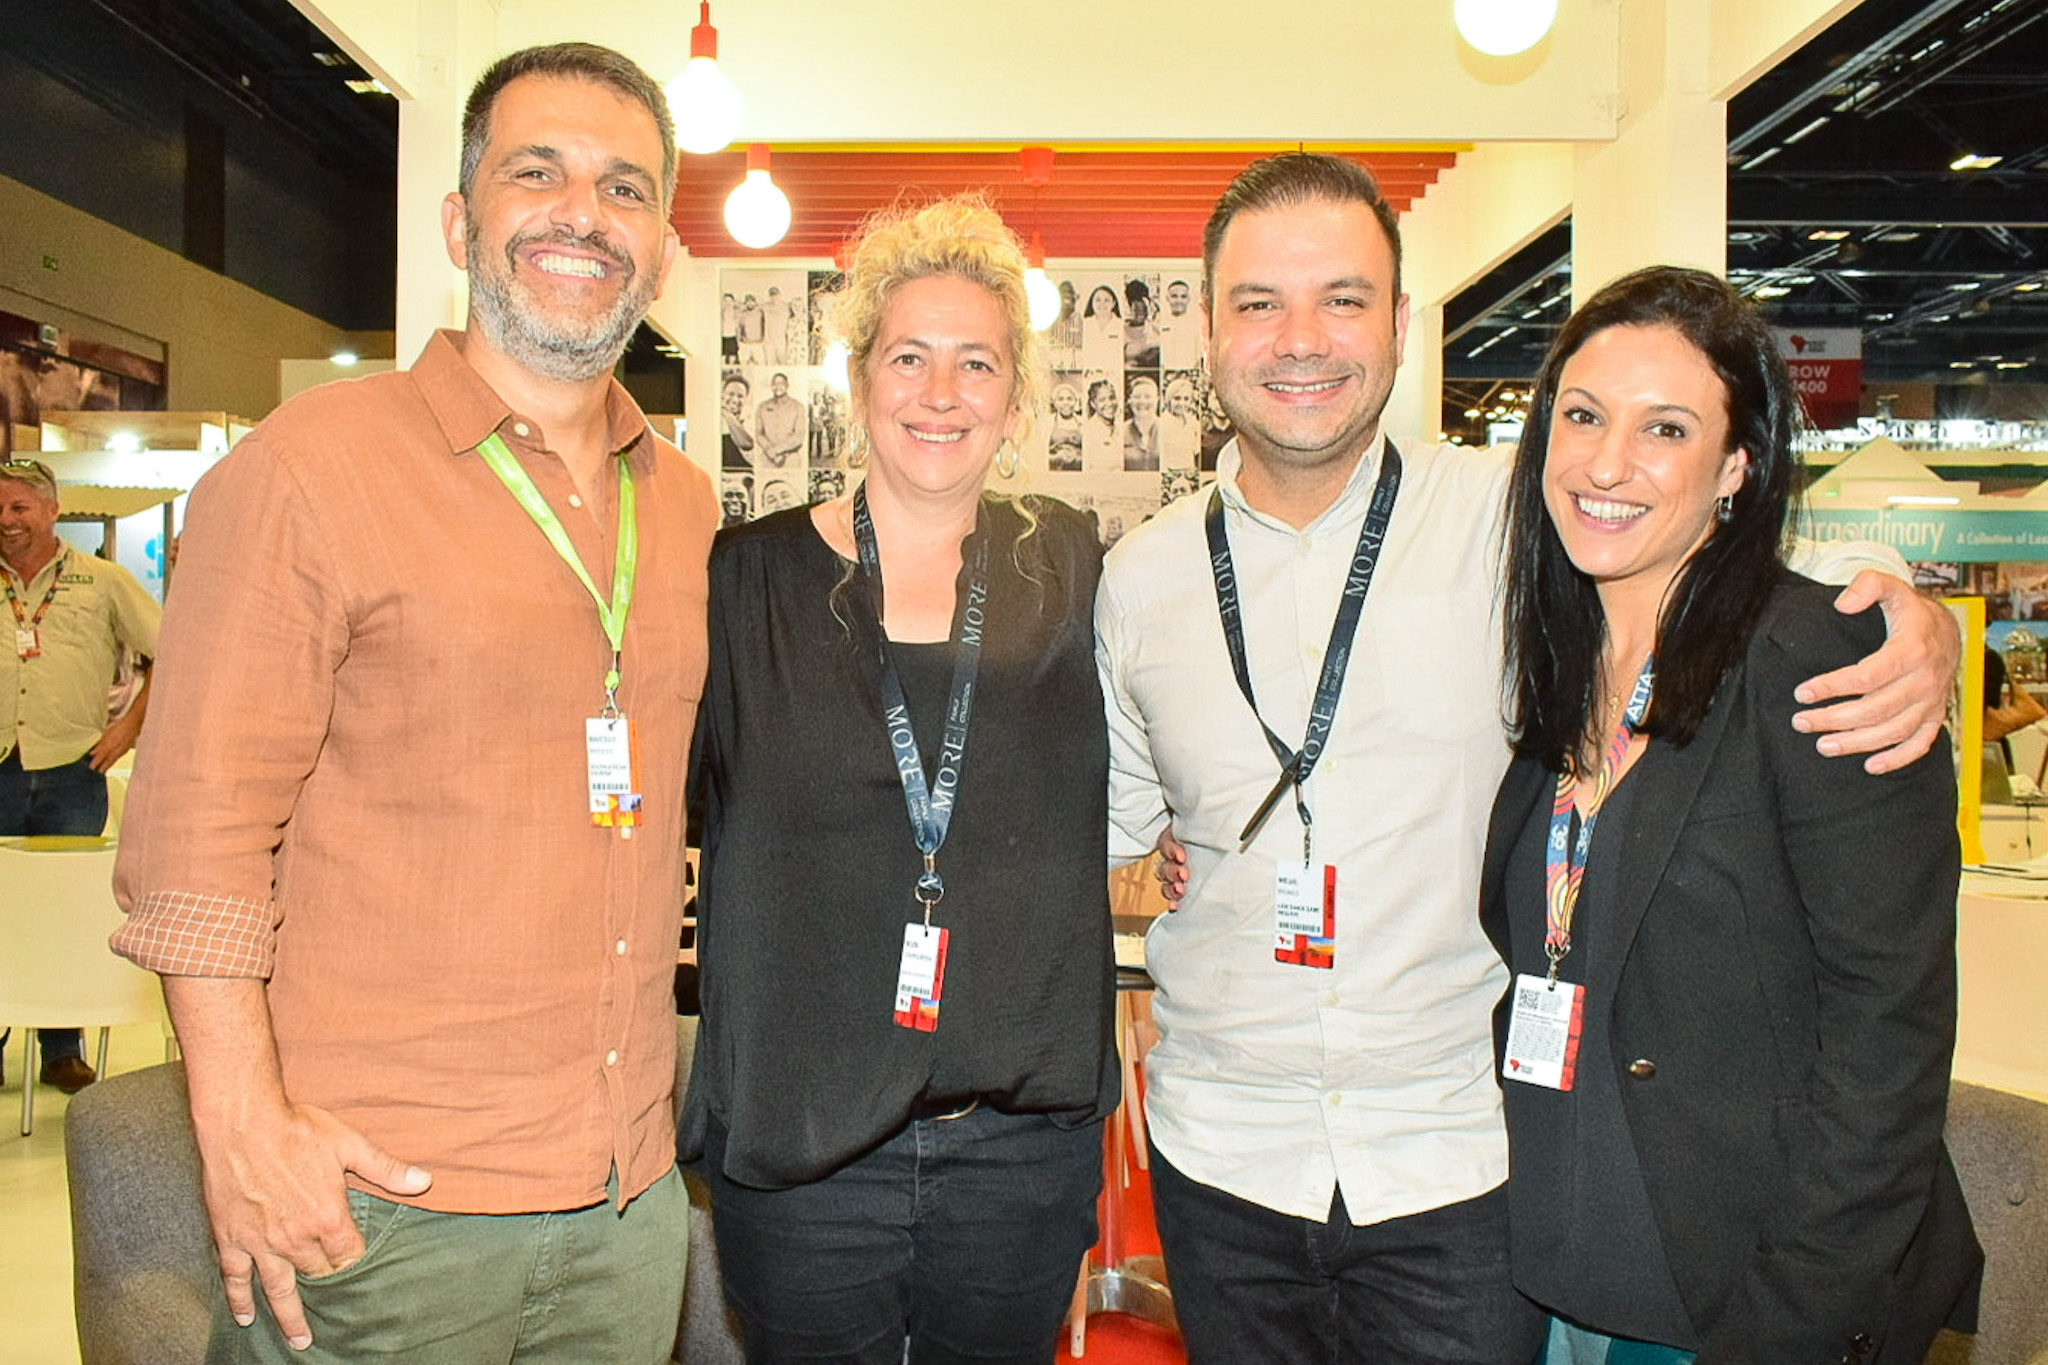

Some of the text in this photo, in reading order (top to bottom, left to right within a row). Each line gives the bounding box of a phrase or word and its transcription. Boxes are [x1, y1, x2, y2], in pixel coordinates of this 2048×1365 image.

[1788, 365, 1831, 379] ROW
[854, 491, 873, 537] ORE
[1800, 510, 1946, 555] traordinary
[1212, 550, 1239, 617] MORE
[1344, 522, 1385, 598] MORE
[962, 578, 988, 646] MORE
[1626, 673, 1656, 721] ATTA
[885, 704, 923, 785] MORE
[931, 732, 965, 812] MORE
